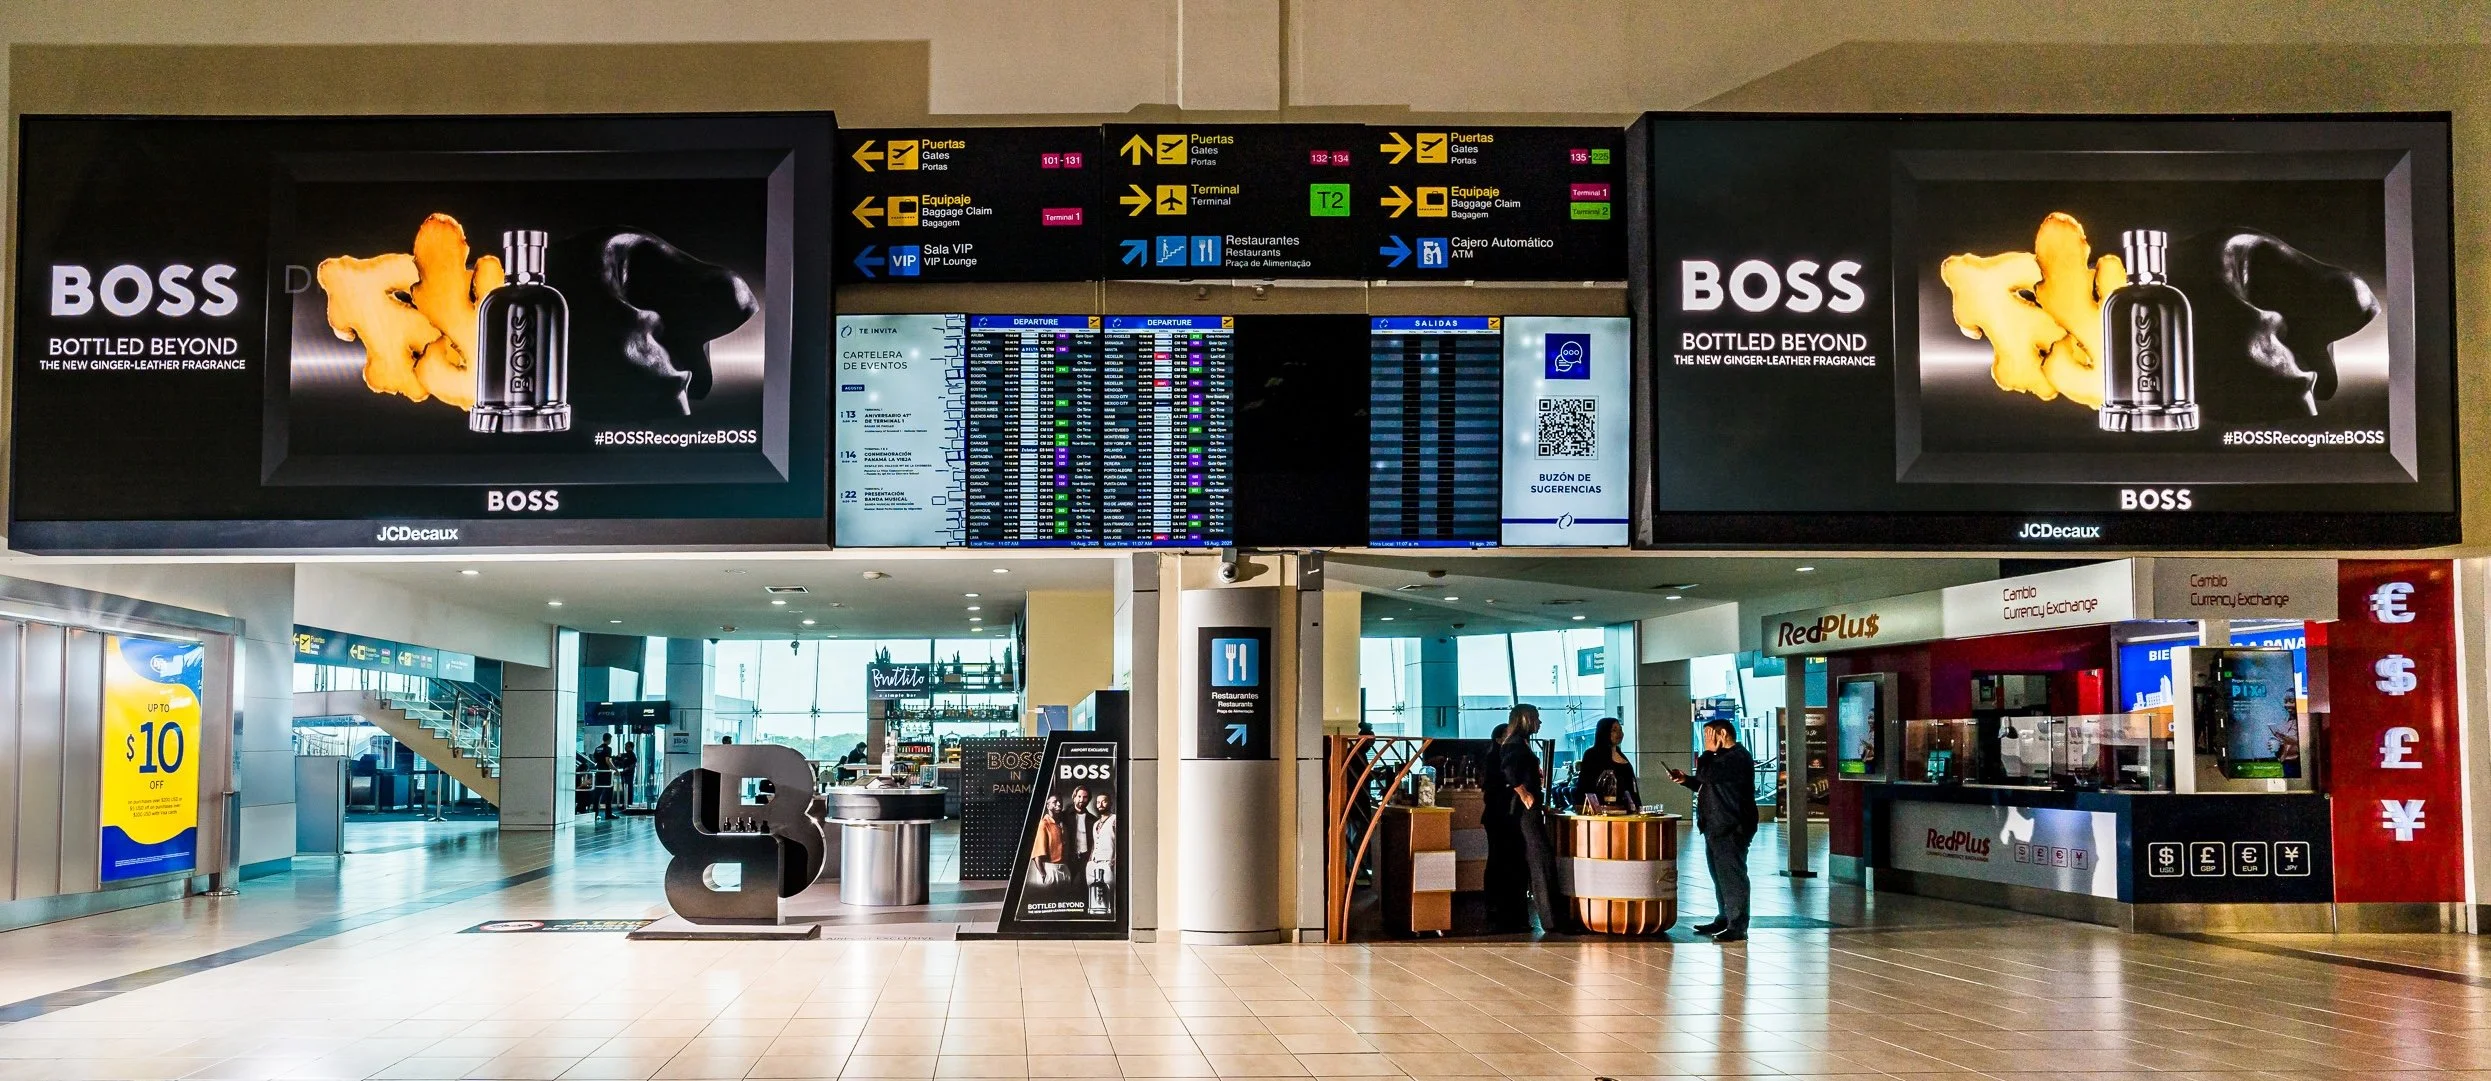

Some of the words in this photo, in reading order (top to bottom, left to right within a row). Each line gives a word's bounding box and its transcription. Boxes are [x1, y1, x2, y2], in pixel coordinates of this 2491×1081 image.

[1191, 134, 1234, 144] Puertas
[1451, 132, 1493, 143] Puertas
[922, 139, 965, 150] Puertas
[1451, 144, 1478, 154] Gates
[922, 151, 949, 160] Gates
[1191, 146, 1218, 155] Gates
[1451, 156, 1477, 164] Portas
[922, 163, 948, 171] Portas
[1192, 184, 1239, 194] Terminal
[1451, 187, 1499, 198] Equipaje
[922, 194, 971, 206] Equipaje
[1191, 197, 1231, 205] Terminal
[1317, 191, 1343, 209] T2
[1451, 199, 1492, 210] Baggage
[1495, 199, 1521, 208] Claim
[922, 206, 963, 217] Baggage
[966, 206, 992, 215] Claim
[1076, 212, 1080, 221] 1
[1451, 211, 1488, 220] Bagagem
[1573, 208, 1600, 216] Terminal
[1602, 208, 1608, 216] 2
[922, 219, 960, 228] Bagagem
[1226, 236, 1299, 246] Restaurantes
[1452, 237, 1487, 249] Cajero
[1491, 236, 1554, 248] Automático
[924, 244, 949, 254] Sala
[953, 244, 973, 254] VIP
[1226, 248, 1281, 257] Restaurants
[1452, 250, 1473, 258] ATM
[893, 255, 916, 266] VIP
[924, 256, 941, 266] VIP
[943, 256, 977, 267] Lounge
[1226, 259, 1249, 268] Praça
[1250, 259, 1260, 267] de
[1262, 259, 1311, 268] Alimentação
[50, 264, 239, 317] BOSS
[1681, 260, 1866, 314] BOSS
[49, 338, 143, 356] BOTTLED
[151, 337, 238, 355] BEYOND
[1682, 334, 1775, 351] BOTTLED
[1782, 333, 1867, 351] BEYOND
[843, 351, 902, 359] CARTELERA
[1674, 356, 1694, 365] THE
[1697, 356, 1721, 365] NEW
[1723, 355, 1810, 366] GINGER-LEATHER
[1812, 356, 1875, 366] FRAGRANCE
[40, 361, 61, 370] THE
[64, 361, 87, 370] NEW
[90, 360, 178, 370] GINGER-LEATHER
[181, 360, 245, 370] FRAGRANCE
[594, 429, 757, 448] #BOSSRecognizeBOSS
[2223, 429, 2385, 448] #BOSSRecognizeBOSS
[1539, 472, 1574, 482] BUZÓN
[1531, 485, 1601, 494] SUGERENCIAS
[488, 491, 559, 511] BOSS
[2121, 489, 2192, 510] BOSS
[377, 526, 458, 542] JCDecaux
[2019, 523, 2100, 539] JCDecaux
[2191, 574, 2227, 588] Cambio
[2004, 586, 2036, 602] Cambio
[2190, 592, 2237, 608] Currency
[2238, 593, 2289, 609] Exchange
[2369, 581, 2416, 624] €
[2004, 602, 2045, 621] Currency
[2047, 598, 2098, 615] Exchange
[2375, 654, 2417, 695] $
[148, 704, 159, 712] UP
[160, 704, 169, 712] TO
[127, 734, 134, 761] $
[139, 722, 184, 773] 10
[2380, 727, 2422, 769] £
[987, 752, 1043, 769] BOSS
[1010, 771, 1021, 780] IN
[1061, 765, 1110, 779] BOSS
[150, 781, 164, 789] OFF
[993, 784, 1034, 793] PANAM
[2381, 800, 2425, 841] ¥
[2076, 852, 2082, 861] ¥
[2159, 846, 2174, 865] $
[2201, 847, 2215, 863] £
[2241, 847, 2257, 863] €
[2285, 847, 2299, 862] ¥
